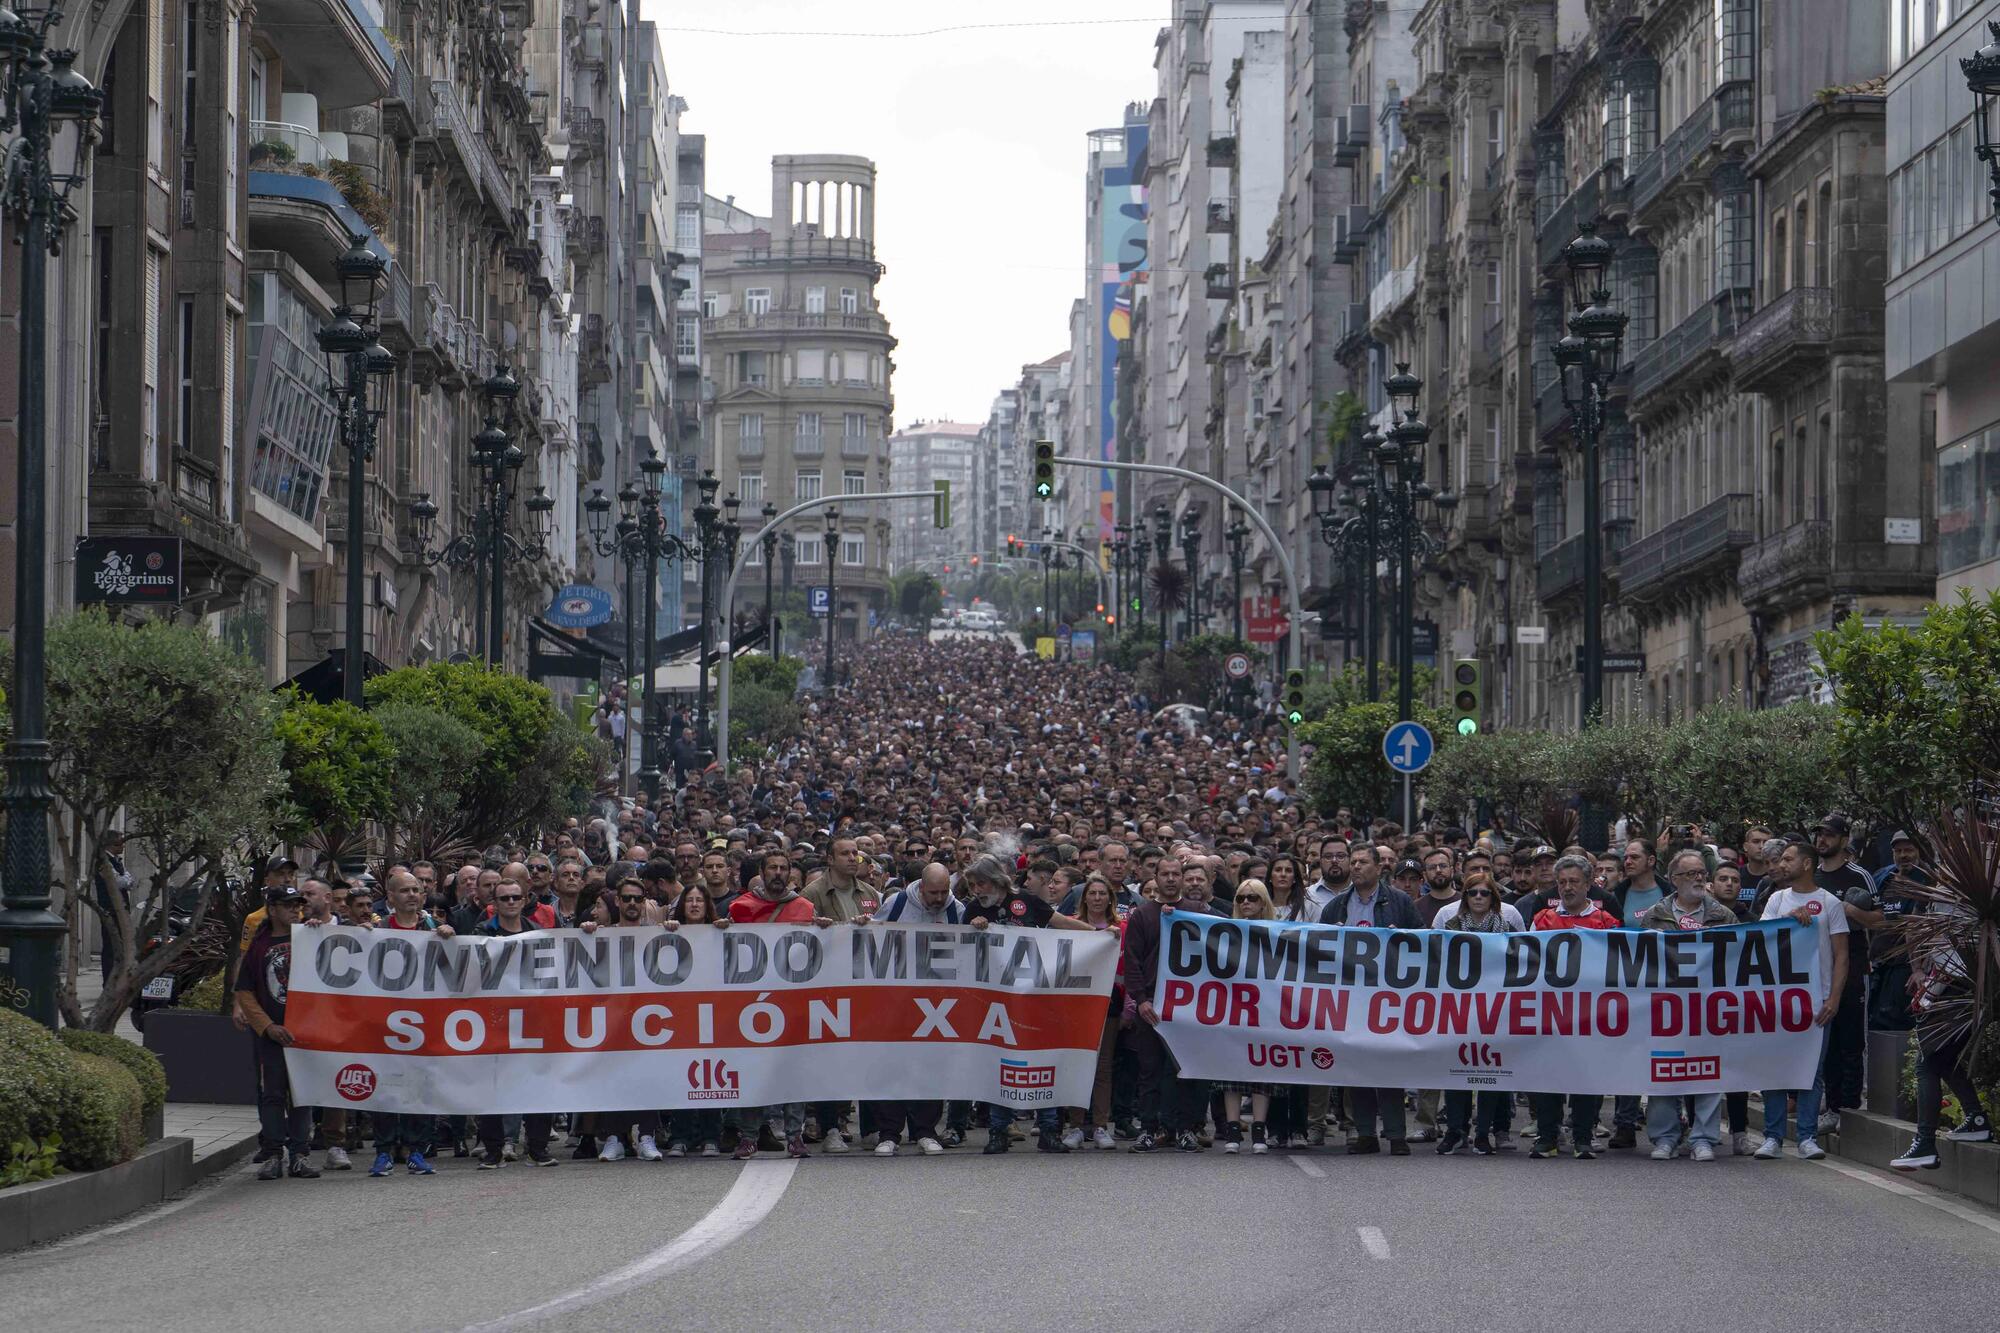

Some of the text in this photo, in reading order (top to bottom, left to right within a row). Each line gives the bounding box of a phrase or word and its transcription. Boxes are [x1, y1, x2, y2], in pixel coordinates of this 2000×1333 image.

[94, 571, 174, 587] Peregrinus
[558, 587, 611, 604] FETERIA
[815, 590, 828, 605] P
[1231, 661, 1245, 669] 40
[315, 929, 1093, 993] CONVENIO DO METAL
[1168, 920, 1809, 989] COMERCIO DO METAL
[1161, 979, 1814, 1037] POR UN CONVENIO DIGNO
[383, 992, 1018, 1051] SOLUCIÓN XA
[1247, 1043, 1305, 1069] UGT
[1458, 1042, 1502, 1067] CIG
[340, 1069, 373, 1087] UGT
[687, 1059, 739, 1089] CIG
[1003, 1069, 1053, 1084] CCOO
[1655, 1060, 1716, 1078] CCOO
[1467, 1077, 1497, 1085] SERVIZOS
[689, 1091, 738, 1099] INDUSTRIA
[1000, 1086, 1054, 1101] industria
